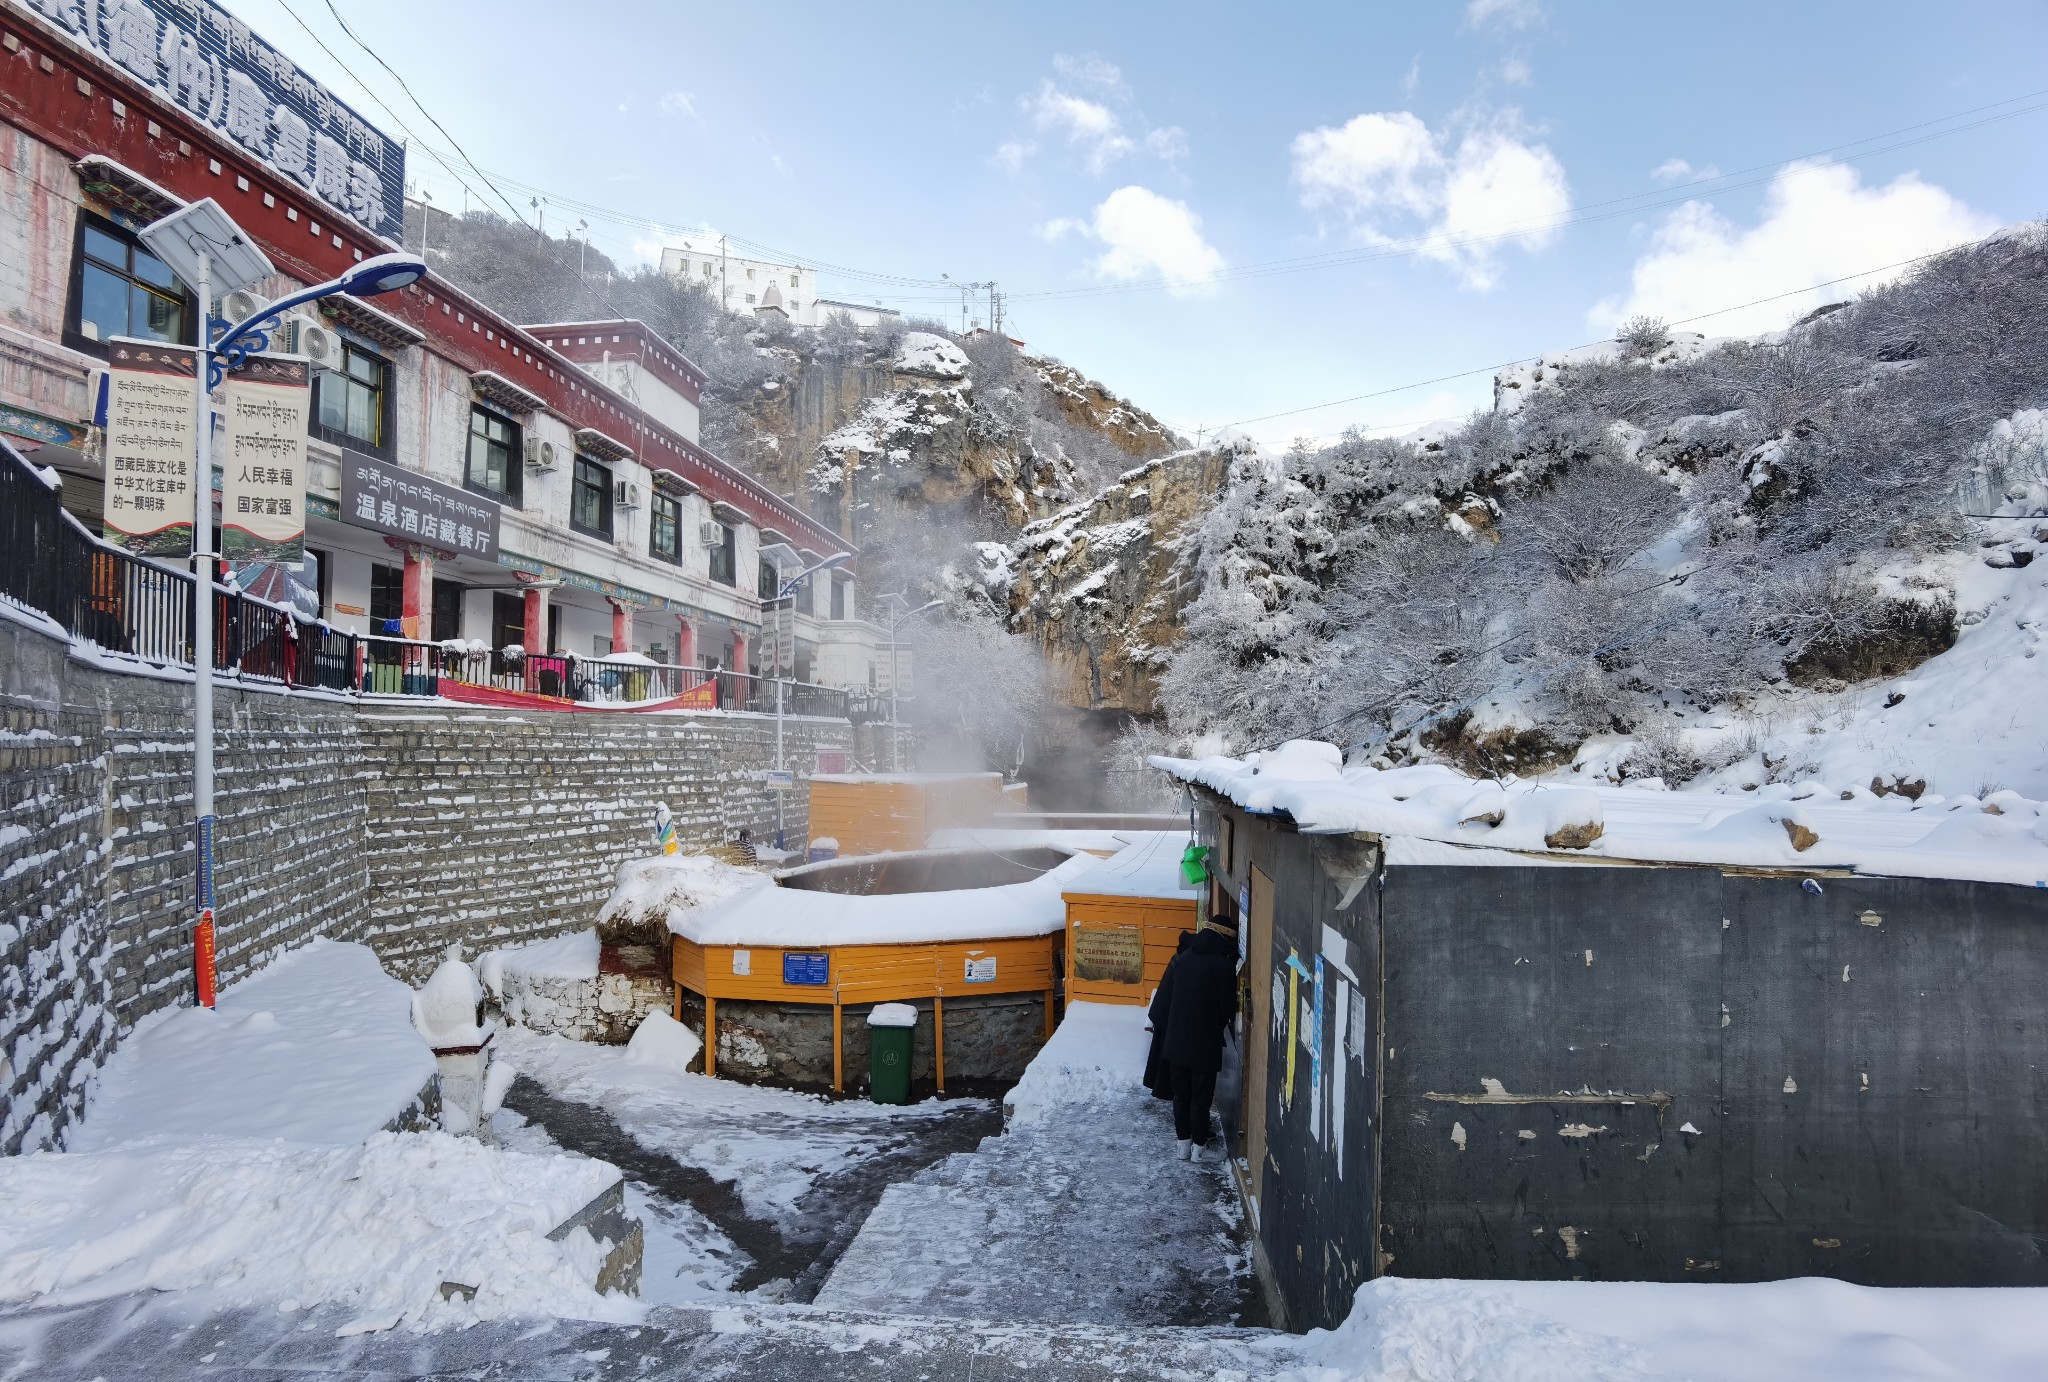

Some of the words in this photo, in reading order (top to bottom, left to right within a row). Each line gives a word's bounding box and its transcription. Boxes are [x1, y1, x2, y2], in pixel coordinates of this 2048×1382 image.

[114, 456, 188, 477] 西藏民族文化是
[238, 464, 293, 487] 人民幸福
[113, 476, 187, 495] 中华文化宝库中
[112, 495, 166, 513] 的一颗明珠
[237, 496, 292, 516] 国家富强
[355, 492, 491, 553] 温泉酒店藏餐厅
